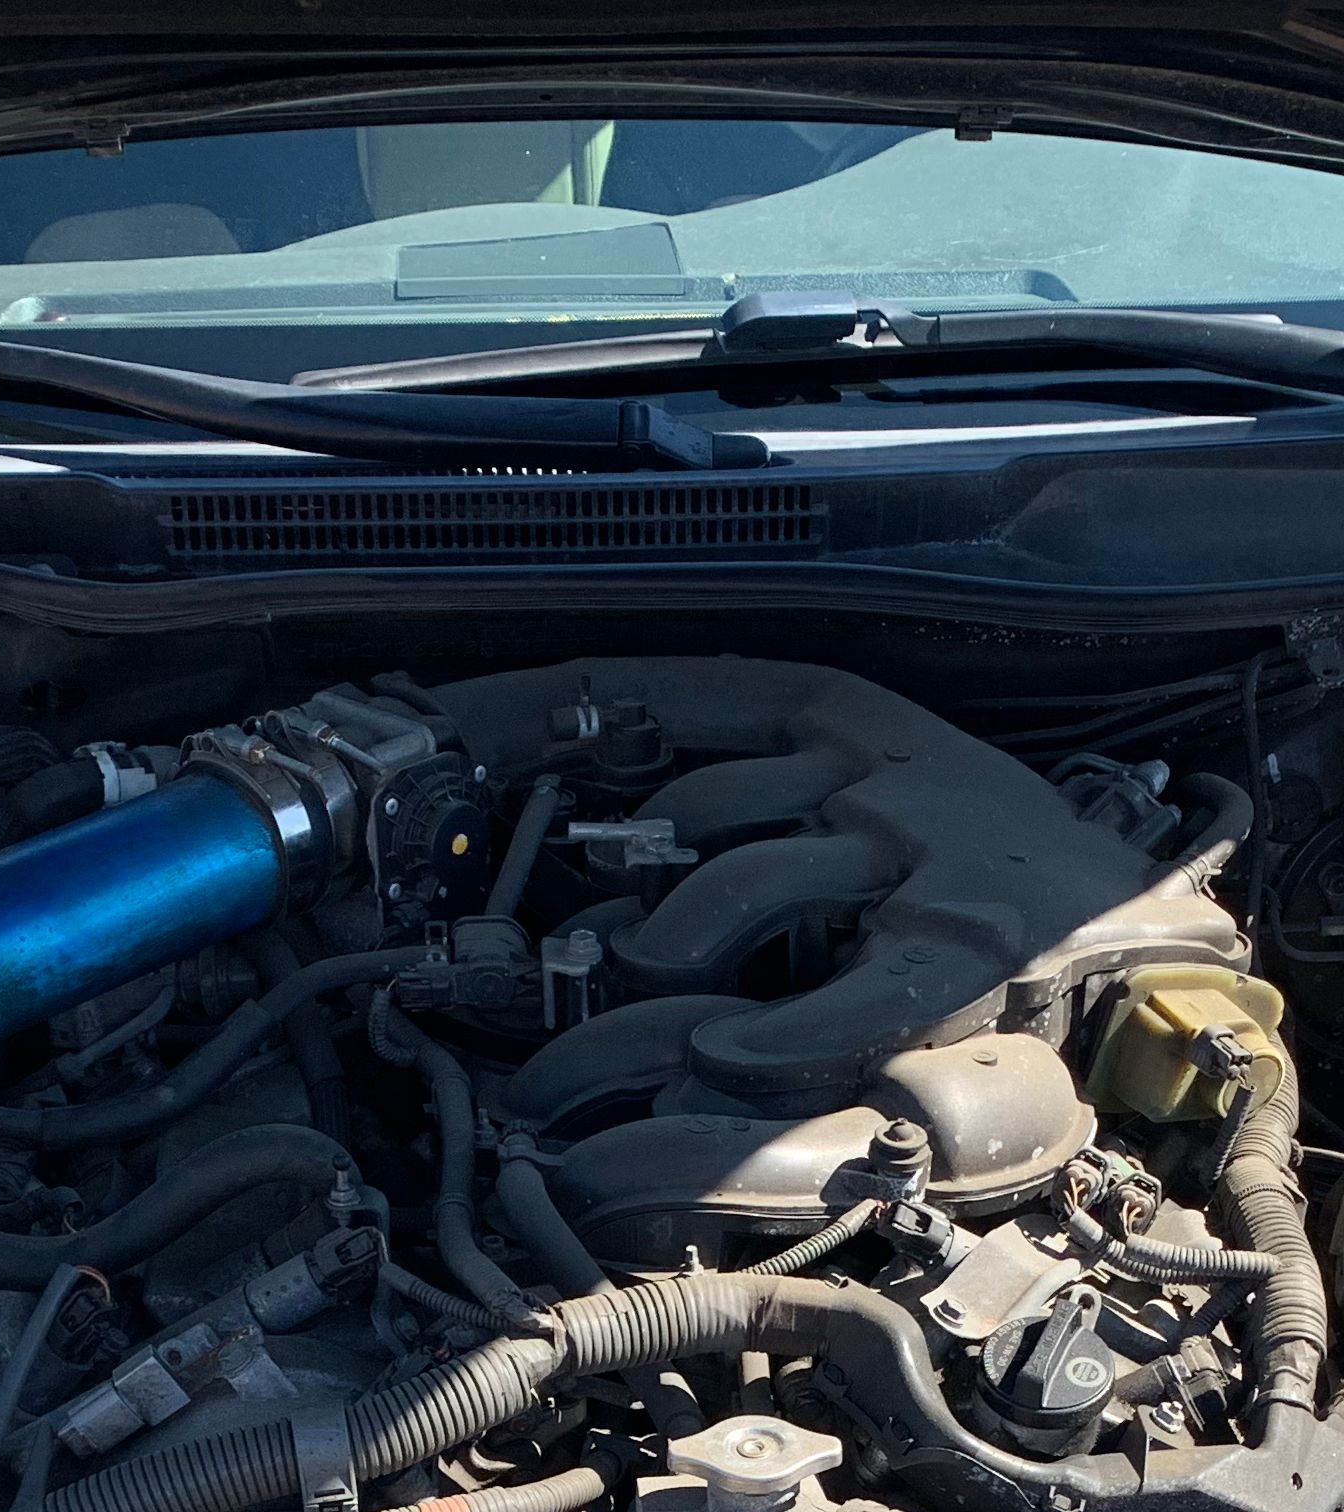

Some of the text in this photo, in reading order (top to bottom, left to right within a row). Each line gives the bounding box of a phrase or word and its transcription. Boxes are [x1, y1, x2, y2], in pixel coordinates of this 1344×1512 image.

[983, 1318, 1027, 1380] ENERGY CONSERVING
[996, 1330, 1023, 1367] SAE 5W-30
